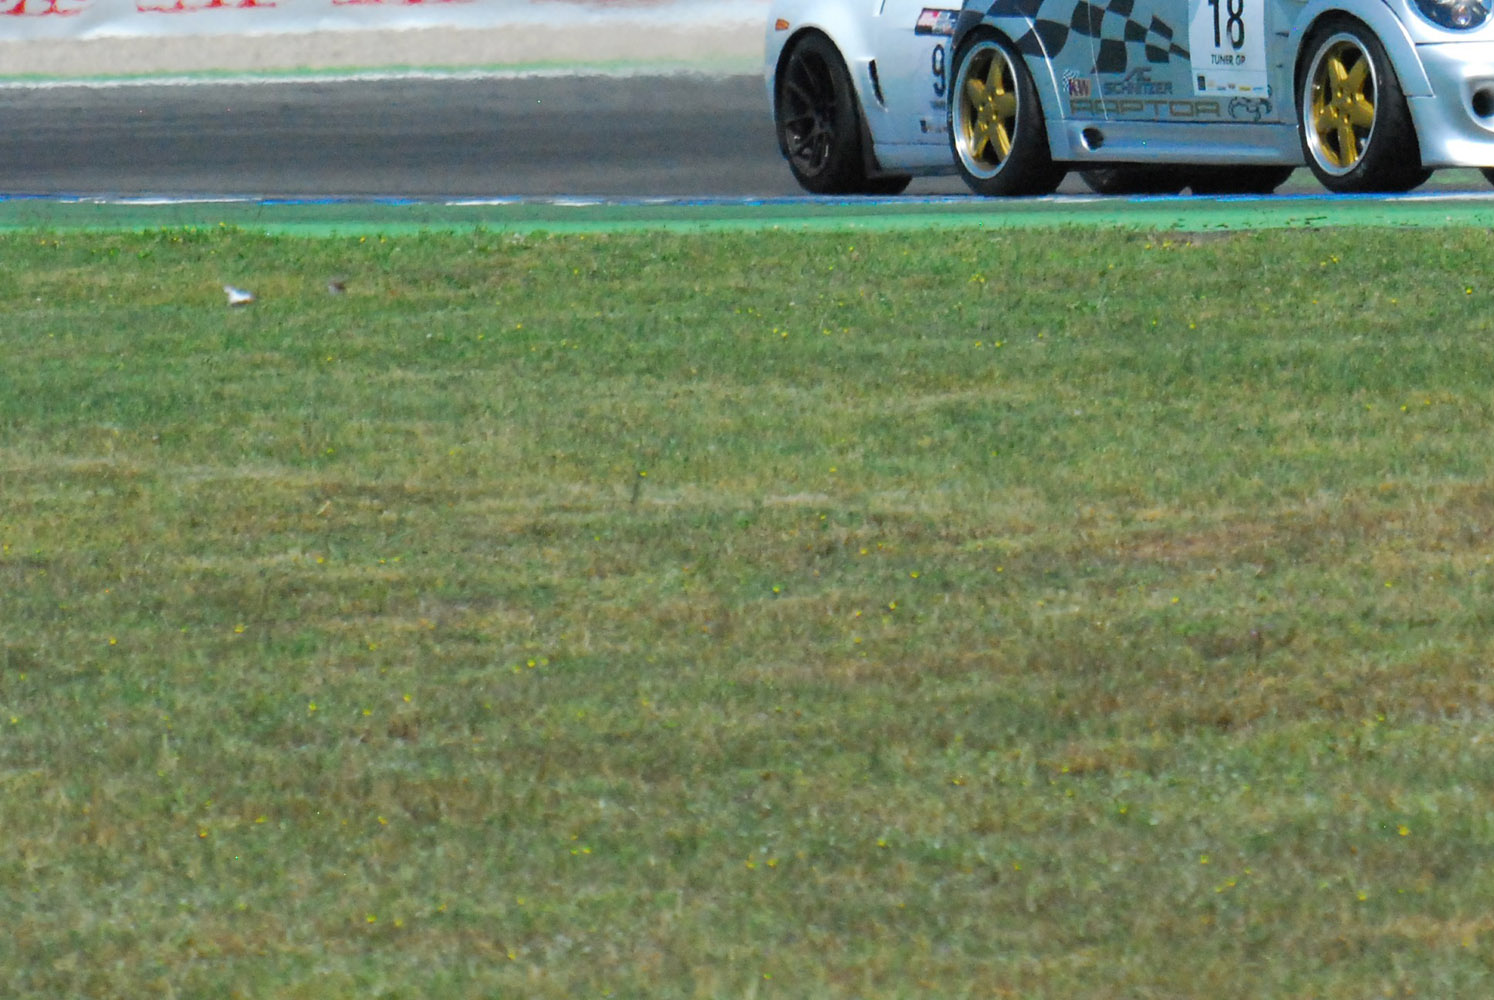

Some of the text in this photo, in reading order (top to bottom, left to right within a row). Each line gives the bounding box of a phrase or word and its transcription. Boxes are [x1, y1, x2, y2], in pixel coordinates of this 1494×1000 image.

[1210, 53, 1246, 66] TUNER GP
[1069, 78, 1091, 97] KW
[1103, 81, 1174, 96] SCHNITZER
[1070, 99, 1221, 118] RAPTOR
